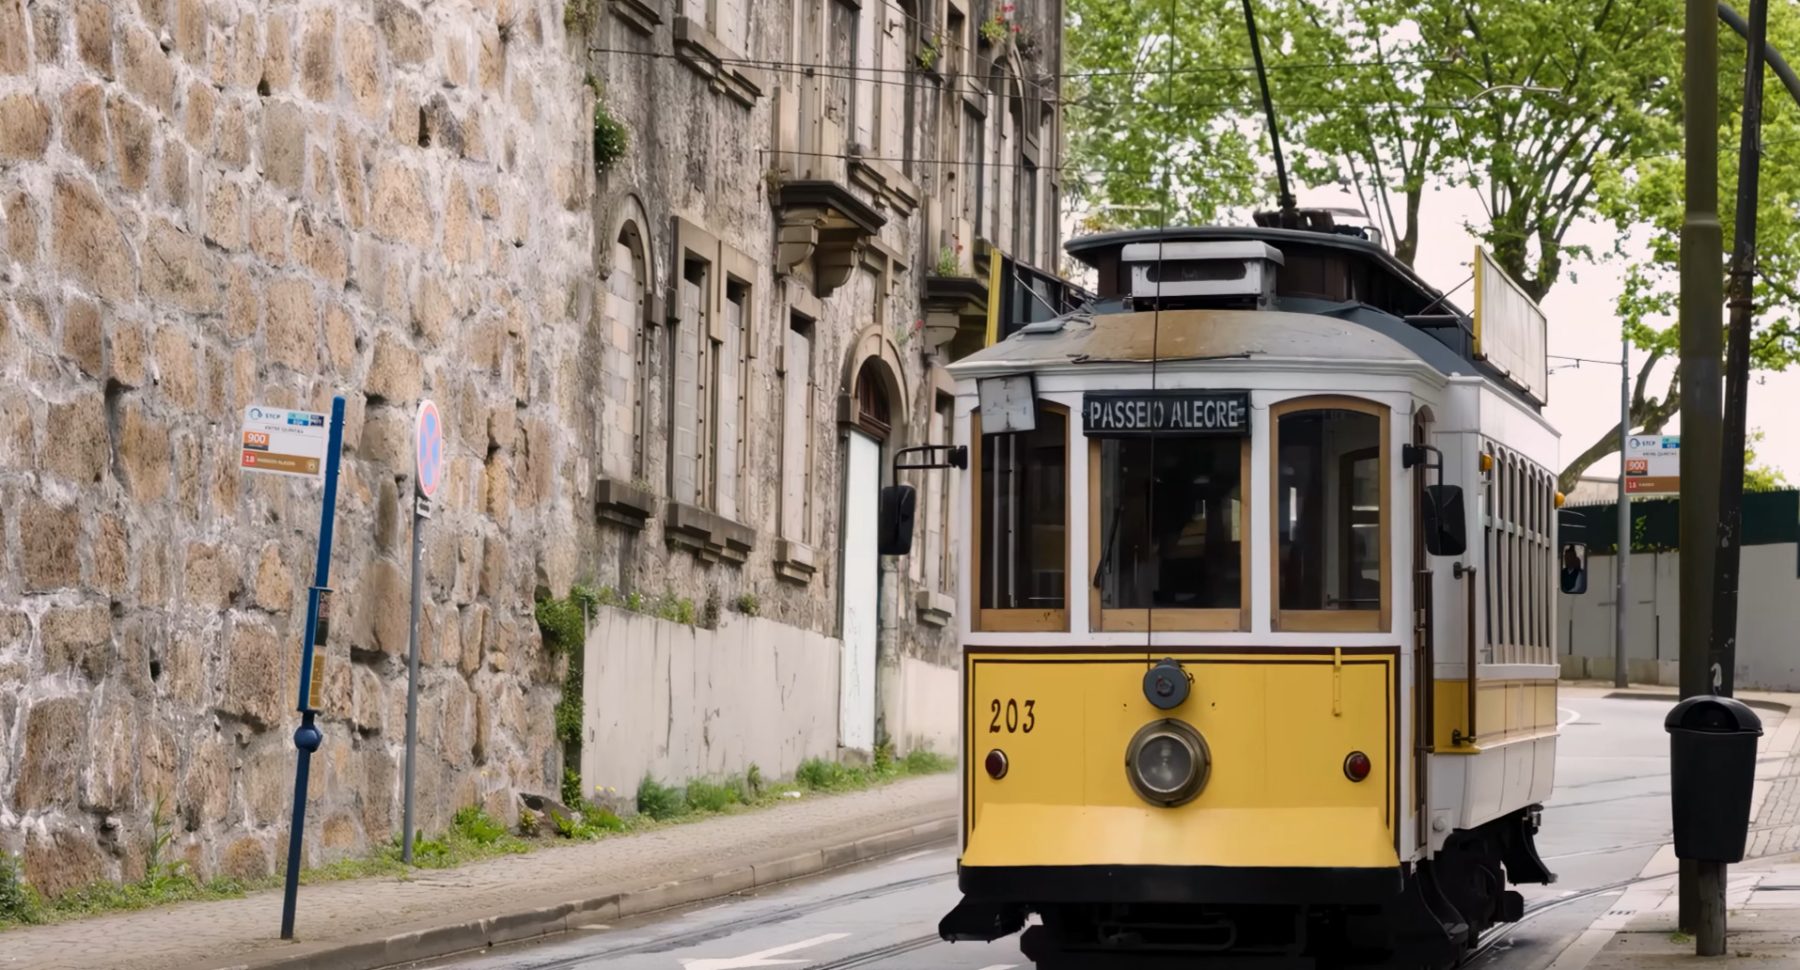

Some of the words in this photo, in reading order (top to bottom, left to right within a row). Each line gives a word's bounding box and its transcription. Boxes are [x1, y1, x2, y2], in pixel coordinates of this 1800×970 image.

[1090, 400, 1164, 428] PASSEIO
[1170, 400, 1239, 428] ALEGRE
[248, 433, 266, 443] 900
[1629, 461, 1645, 470] 900
[989, 698, 1036, 733] 203
